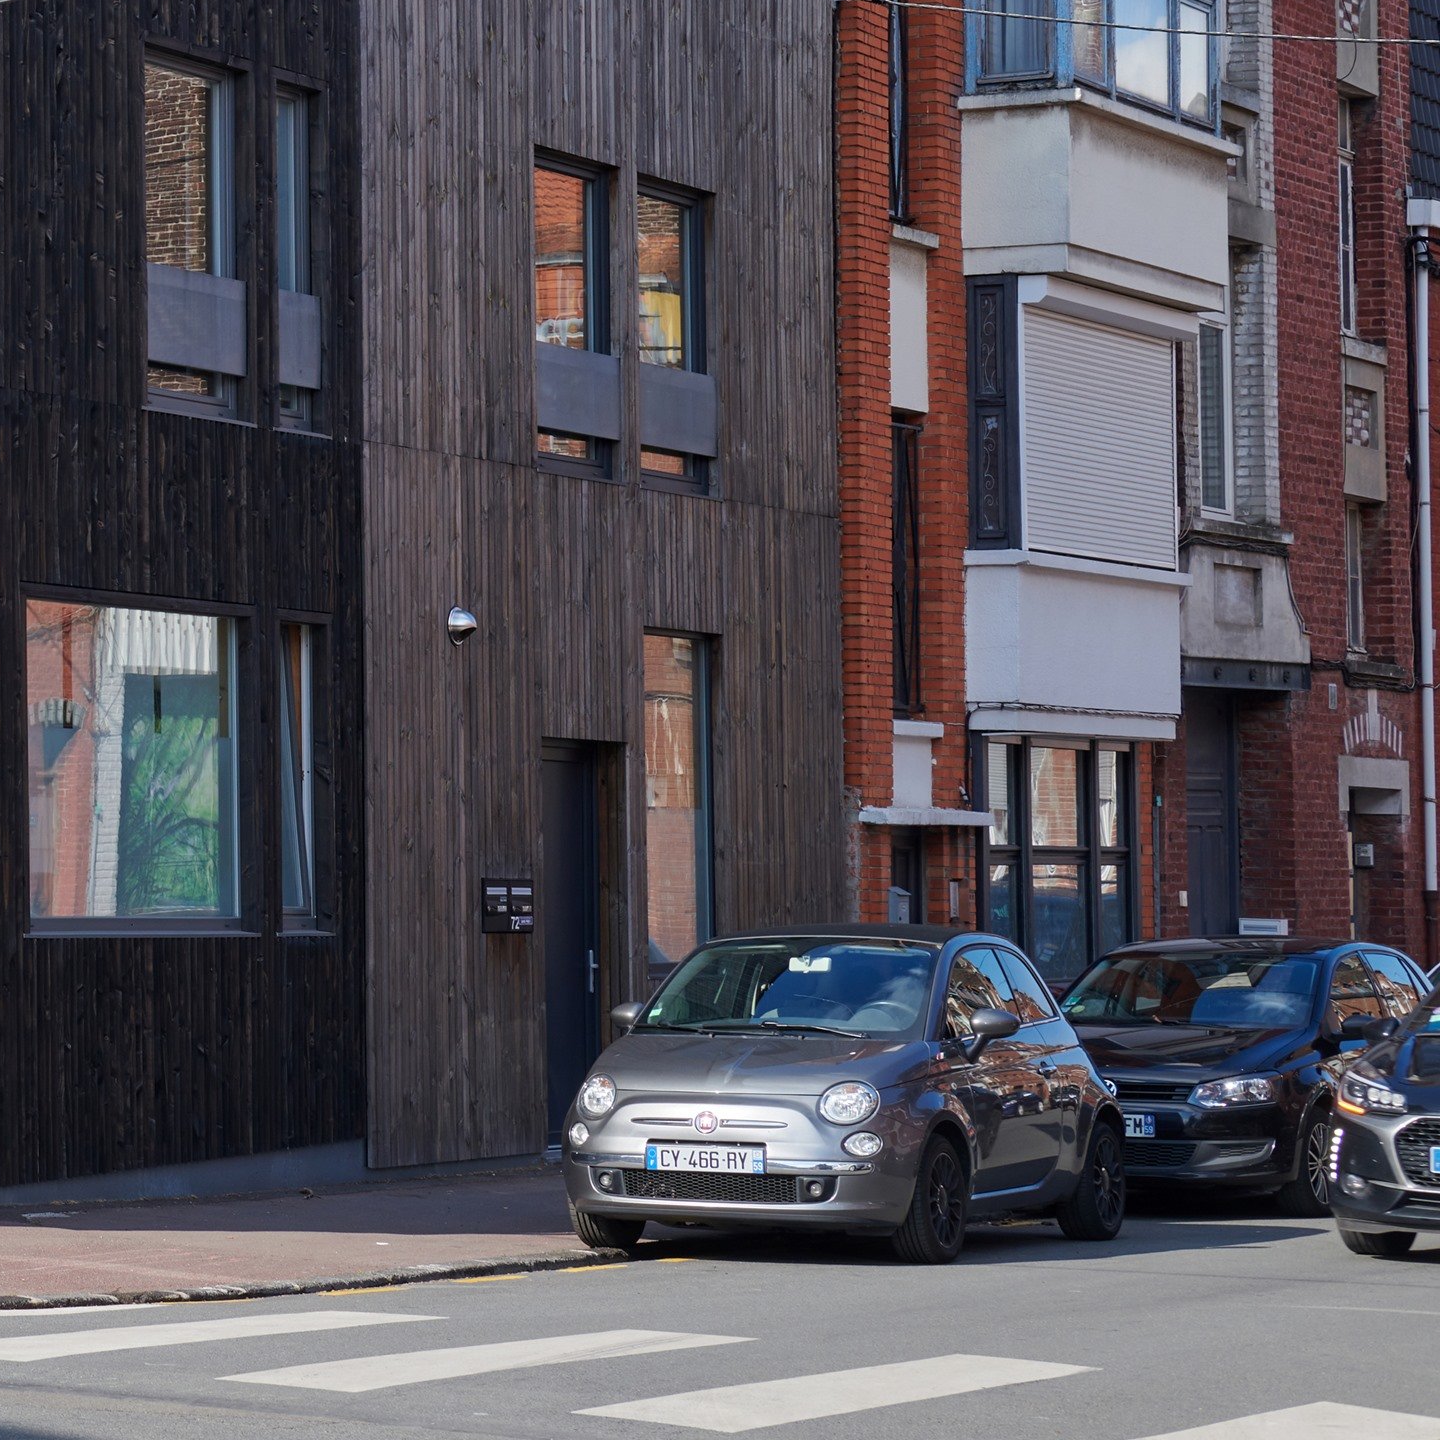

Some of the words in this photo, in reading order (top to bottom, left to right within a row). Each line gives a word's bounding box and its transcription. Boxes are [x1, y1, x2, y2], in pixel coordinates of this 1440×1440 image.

[511, 916, 520, 930] 72
[1144, 1125, 1153, 1134] 59
[660, 1149, 747, 1169] CY-466-RY
[753, 1161, 763, 1171] 59
